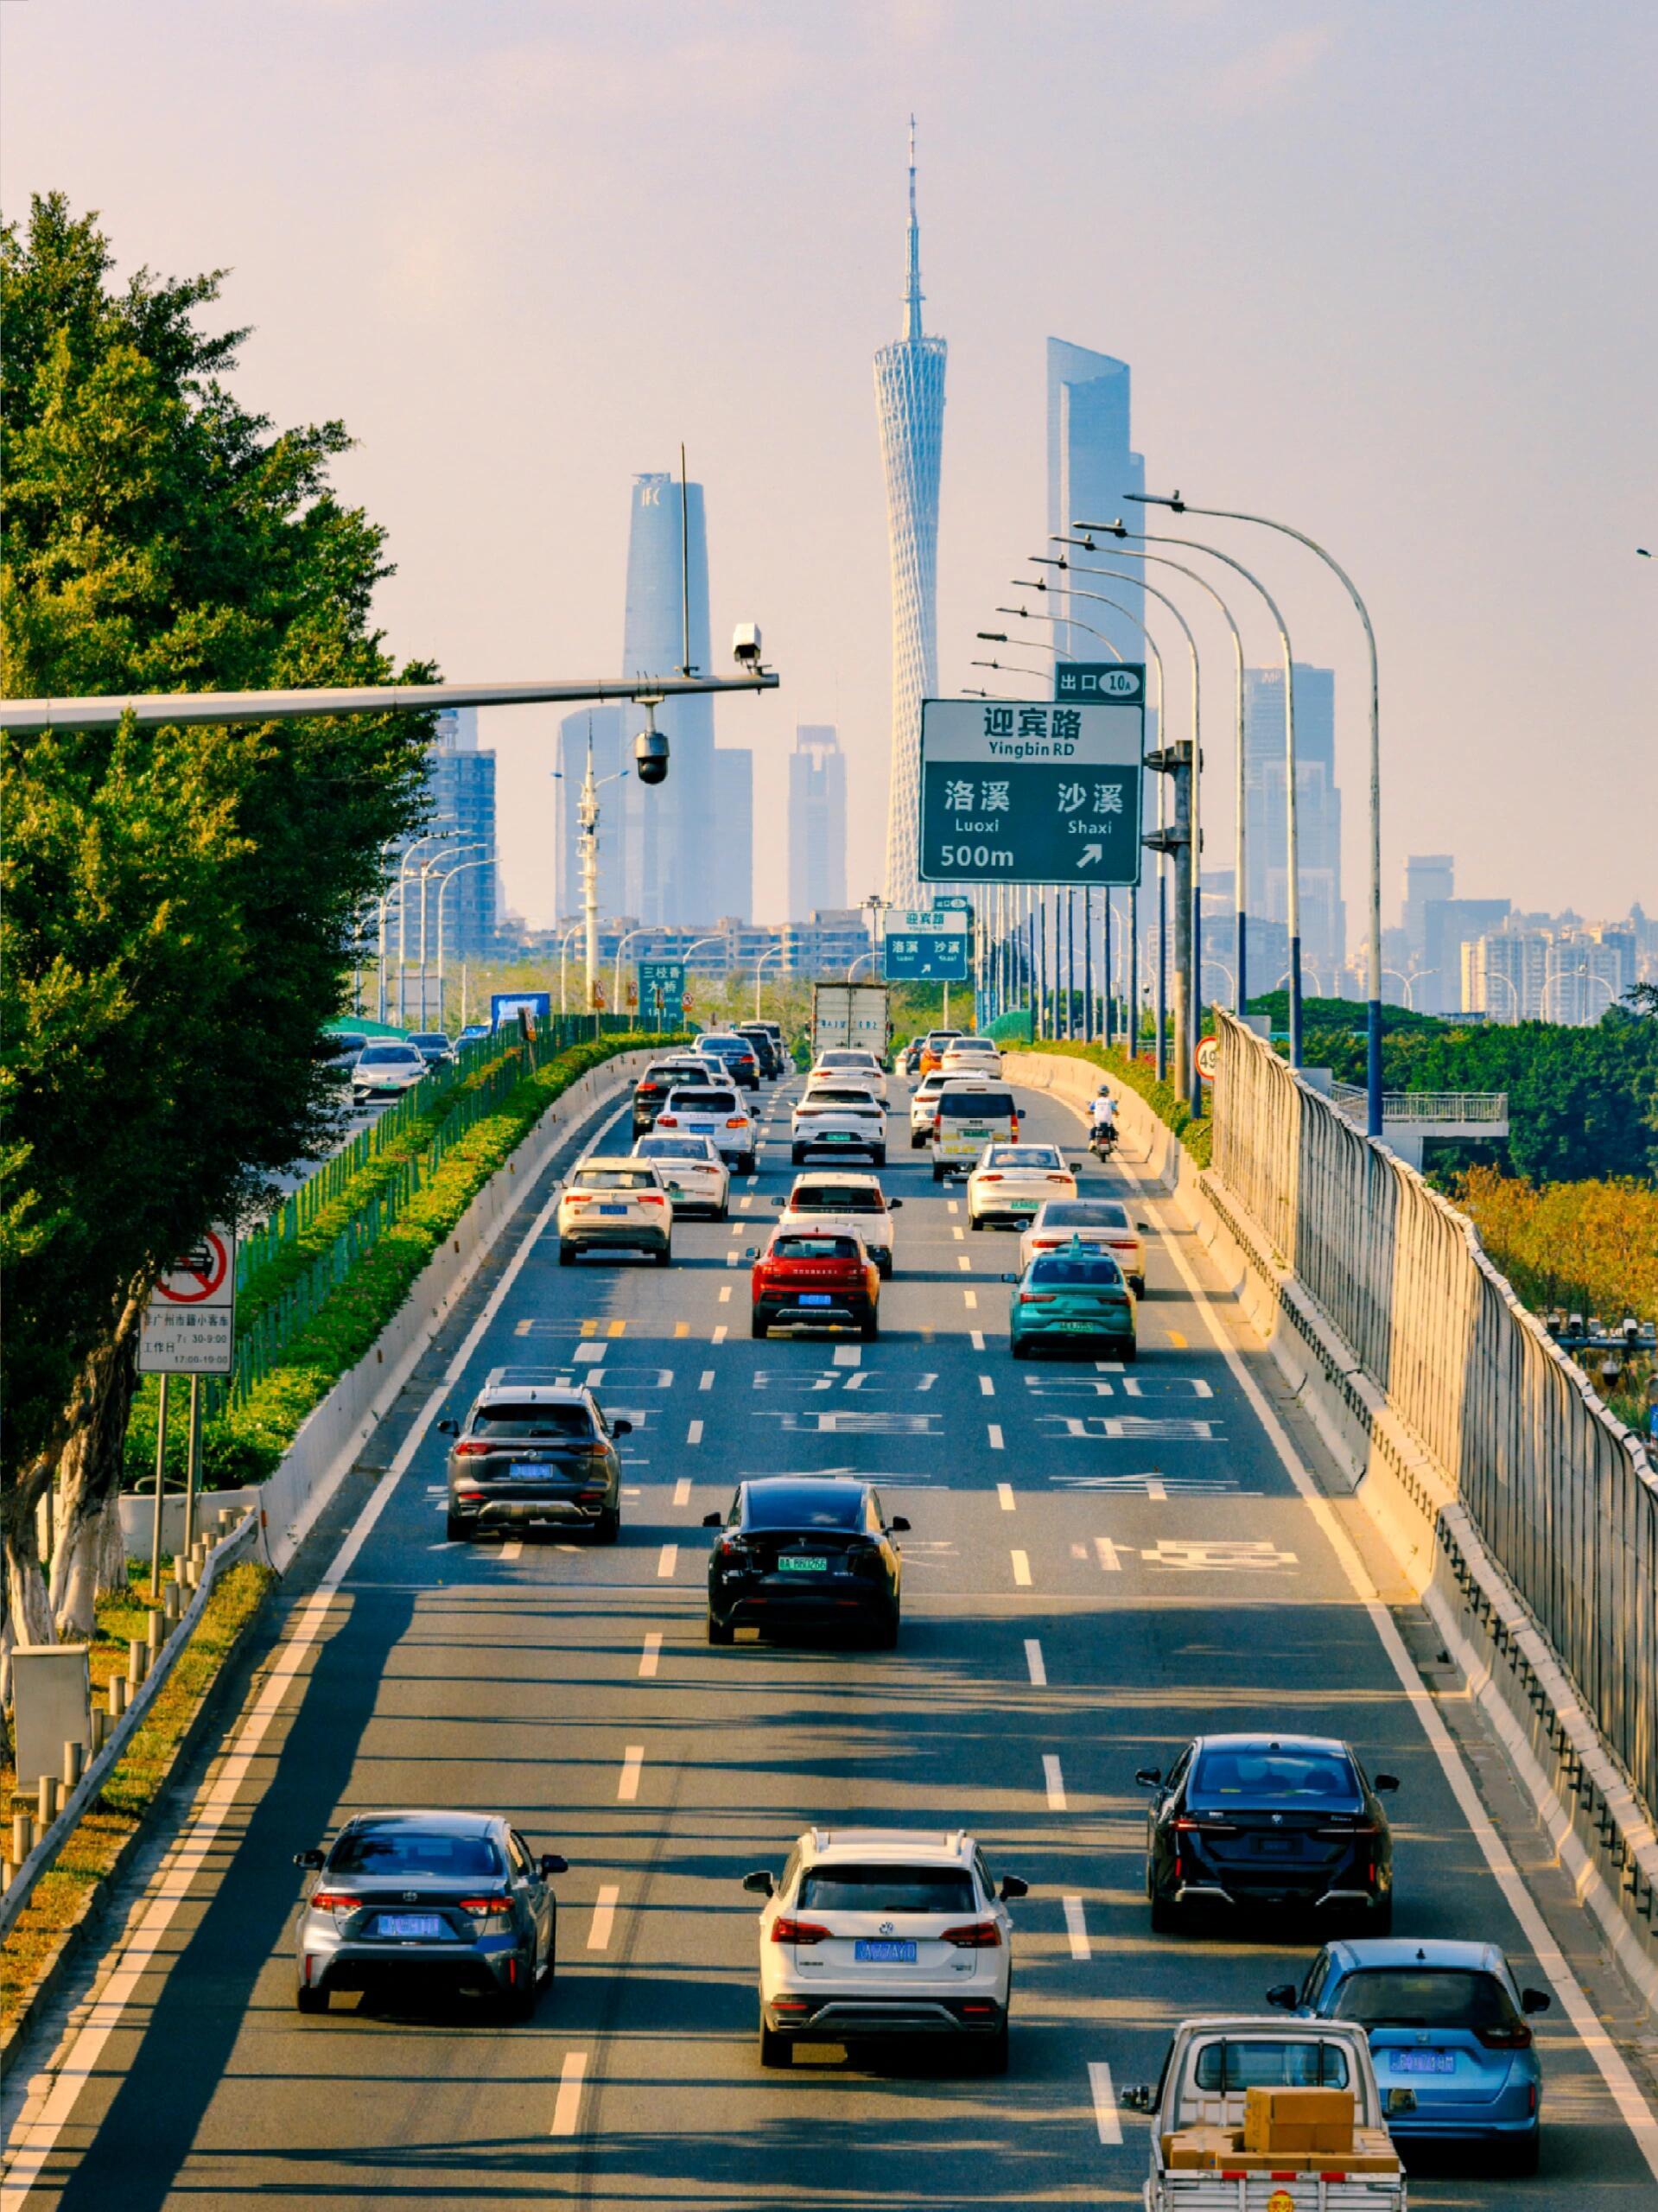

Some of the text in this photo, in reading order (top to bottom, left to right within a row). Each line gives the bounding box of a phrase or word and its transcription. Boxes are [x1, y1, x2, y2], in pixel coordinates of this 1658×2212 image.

[1061, 674, 1097, 690] 出口
[984, 707, 1082, 740] 迎宾路
[989, 741, 1075, 760] Yingbin RD
[944, 780, 1123, 815] 洛溪 沙溪
[955, 818, 1112, 835] Luoxi Shaxi
[941, 845, 1014, 867] 500m
